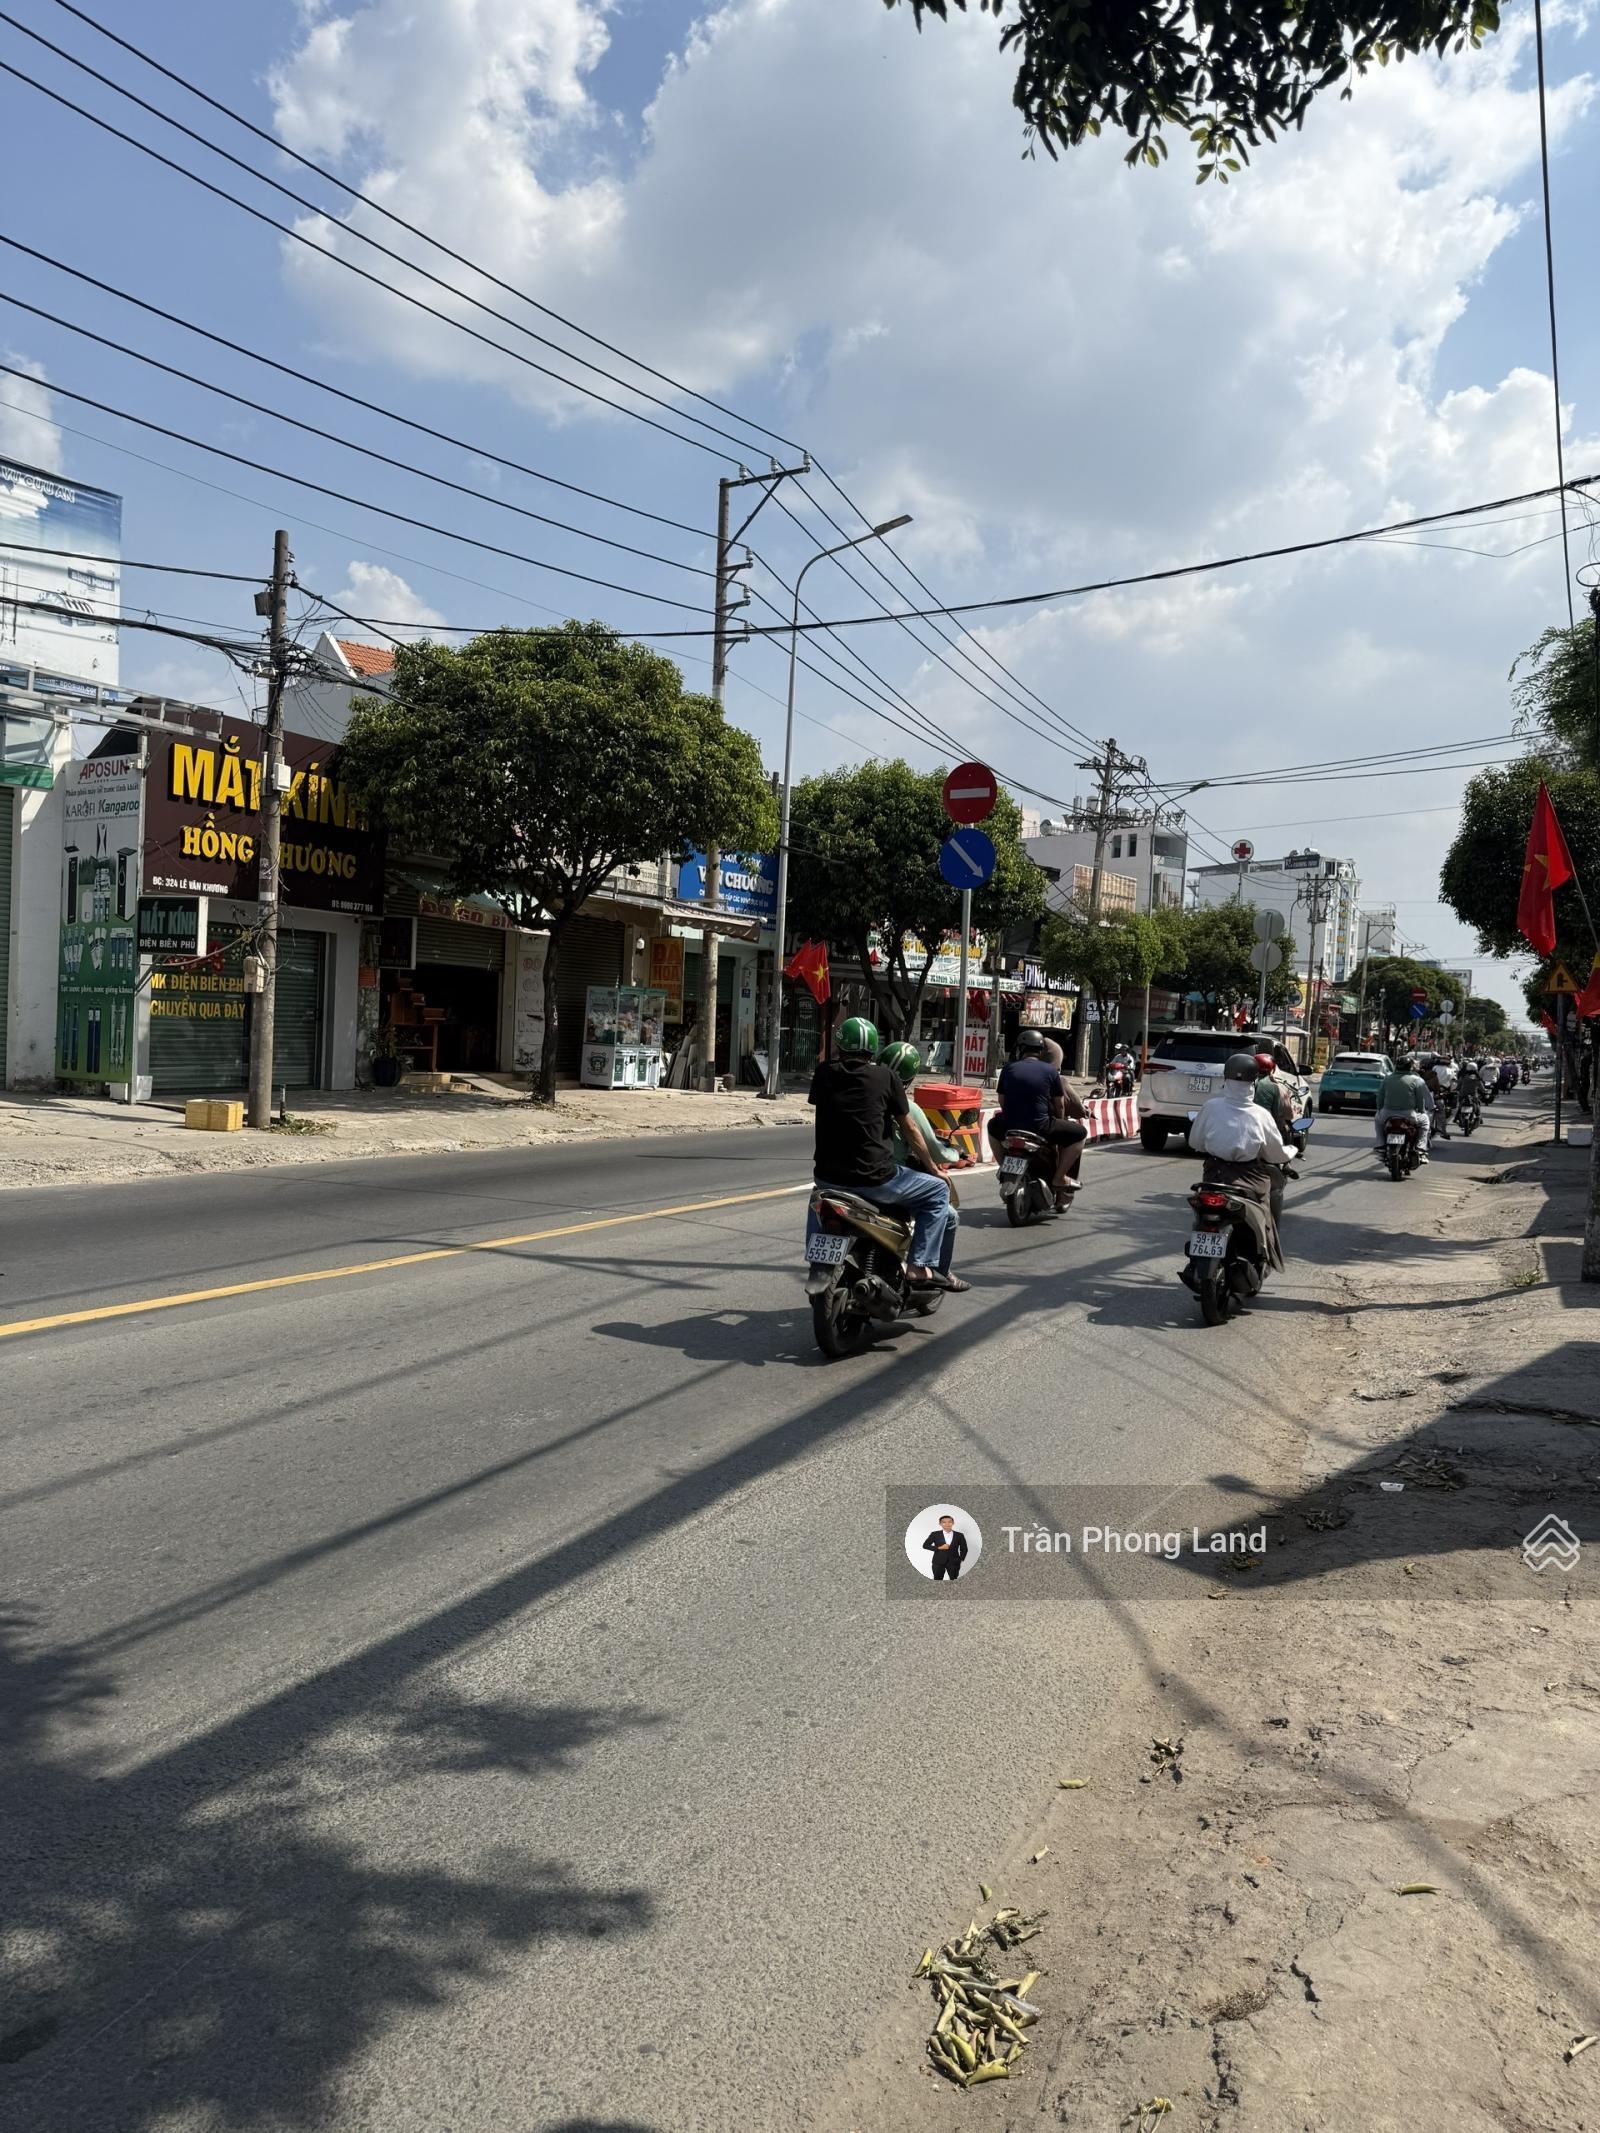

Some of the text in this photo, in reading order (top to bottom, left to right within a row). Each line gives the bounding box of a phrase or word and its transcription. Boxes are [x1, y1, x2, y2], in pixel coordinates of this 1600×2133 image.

[79, 759, 130, 780] APOSUN
[98, 799, 140, 815] Kangaroo
[181, 812, 255, 864] HỒNG
[165, 878, 178, 887] 324
[180, 878, 188, 889] LÊ
[189, 880, 202, 891] VĂN
[168, 905, 196, 935] KÍNH
[140, 938, 195, 949] ĐIỆN BIÊN PHỦ
[171, 972, 198, 992] ĐIỆN
[200, 974, 226, 992] BIÊN
[229, 978, 245, 992] PH
[150, 994, 245, 1019] CHUYỂN QUA ĐÂY
[965, 1053, 985, 1072] ÍNH
[814, 1235, 843, 1250] 59-S3
[1193, 1244, 1223, 1256] 764.63
[808, 1248, 842, 1262] 555.88
